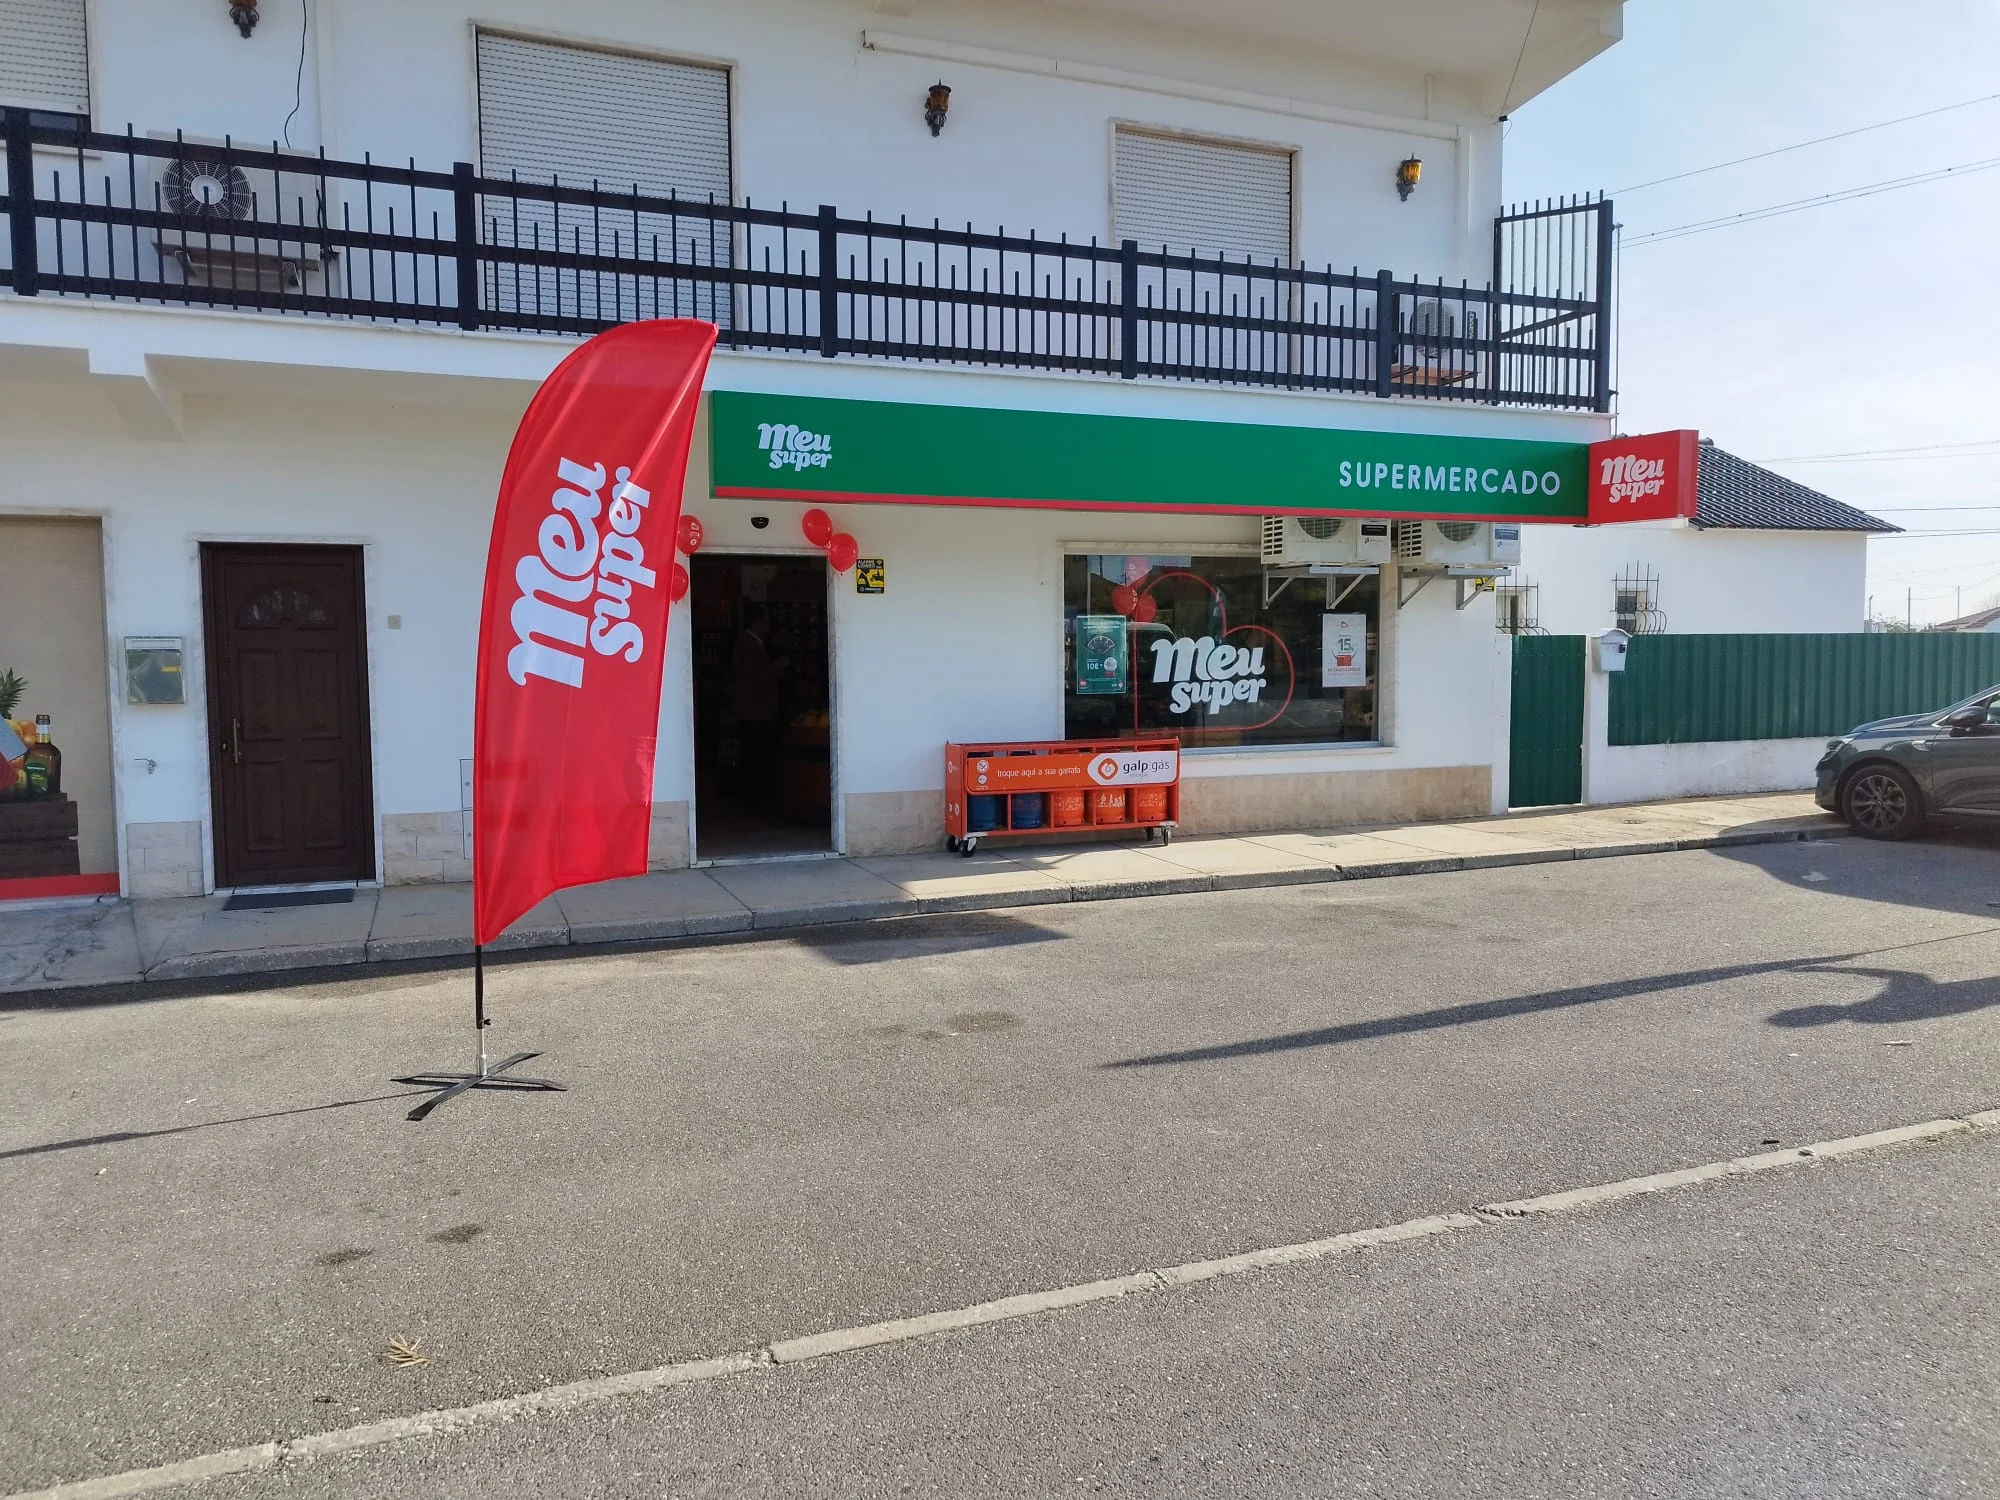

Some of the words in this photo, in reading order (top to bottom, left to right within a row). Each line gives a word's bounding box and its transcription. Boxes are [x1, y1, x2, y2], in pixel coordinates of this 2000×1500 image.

[769, 450, 832, 471] super
[1339, 461, 1561, 496] SUPERMERCADO
[1609, 479, 1665, 503] super
[590, 466, 656, 663] super
[1169, 679, 1267, 715] super
[1022, 767, 1036, 777] aqui
[1123, 760, 1148, 774] galp
